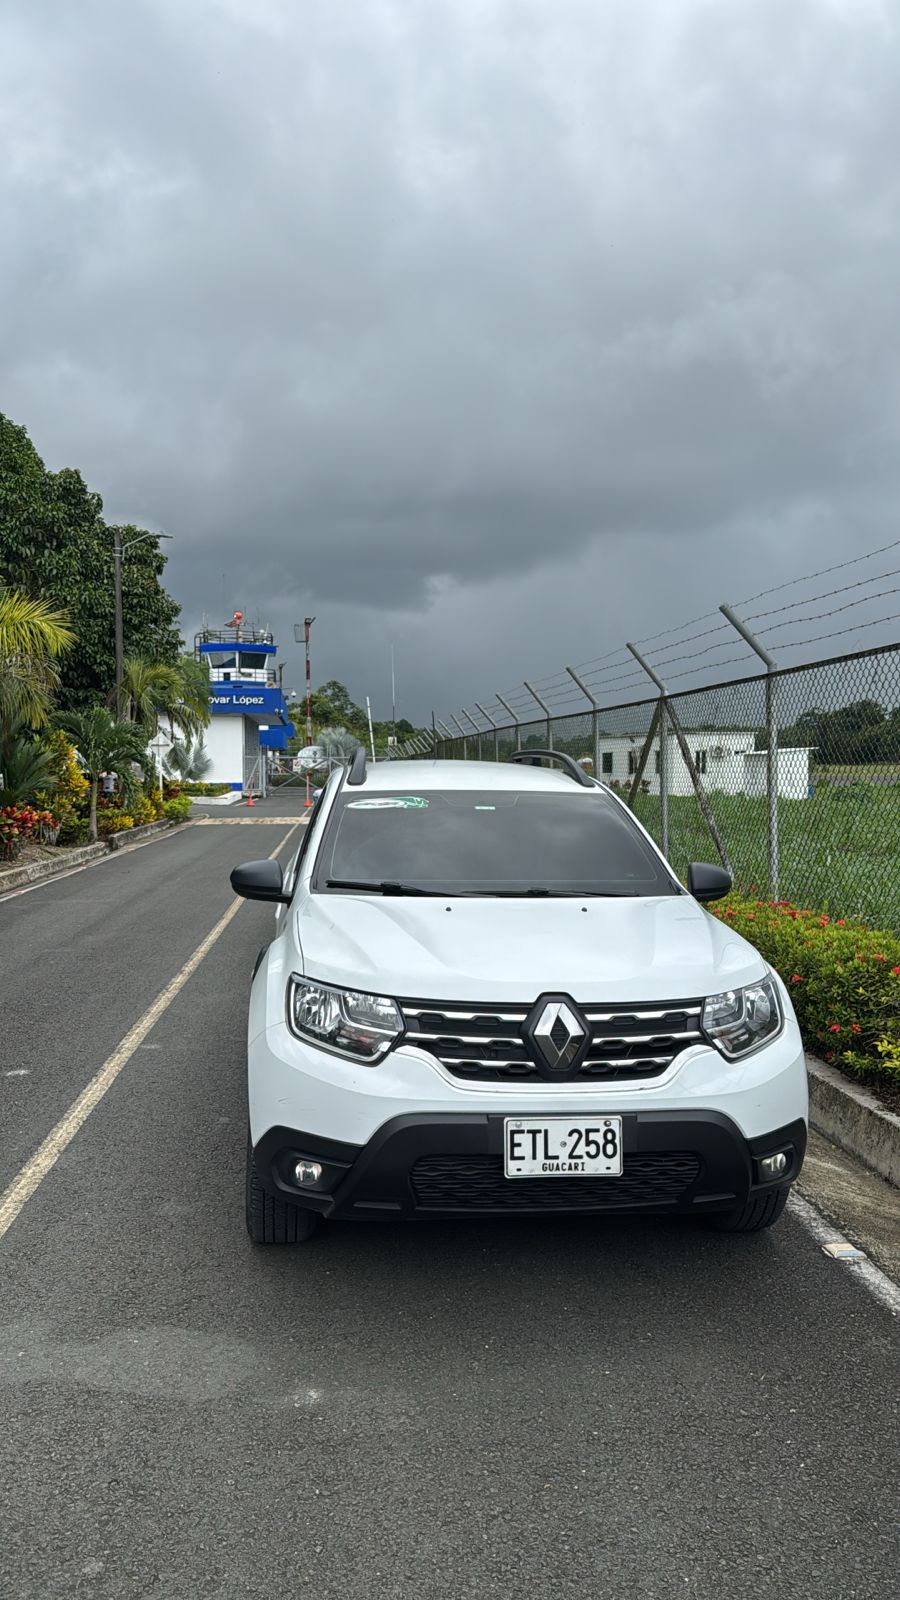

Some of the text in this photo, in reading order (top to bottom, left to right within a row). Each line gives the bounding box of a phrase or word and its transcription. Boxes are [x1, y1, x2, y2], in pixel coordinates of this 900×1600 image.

[207, 696, 231, 704] ovar
[233, 695, 264, 705] López
[509, 1128, 618, 1161] ETL 258
[541, 1162, 586, 1172] GUACARI
